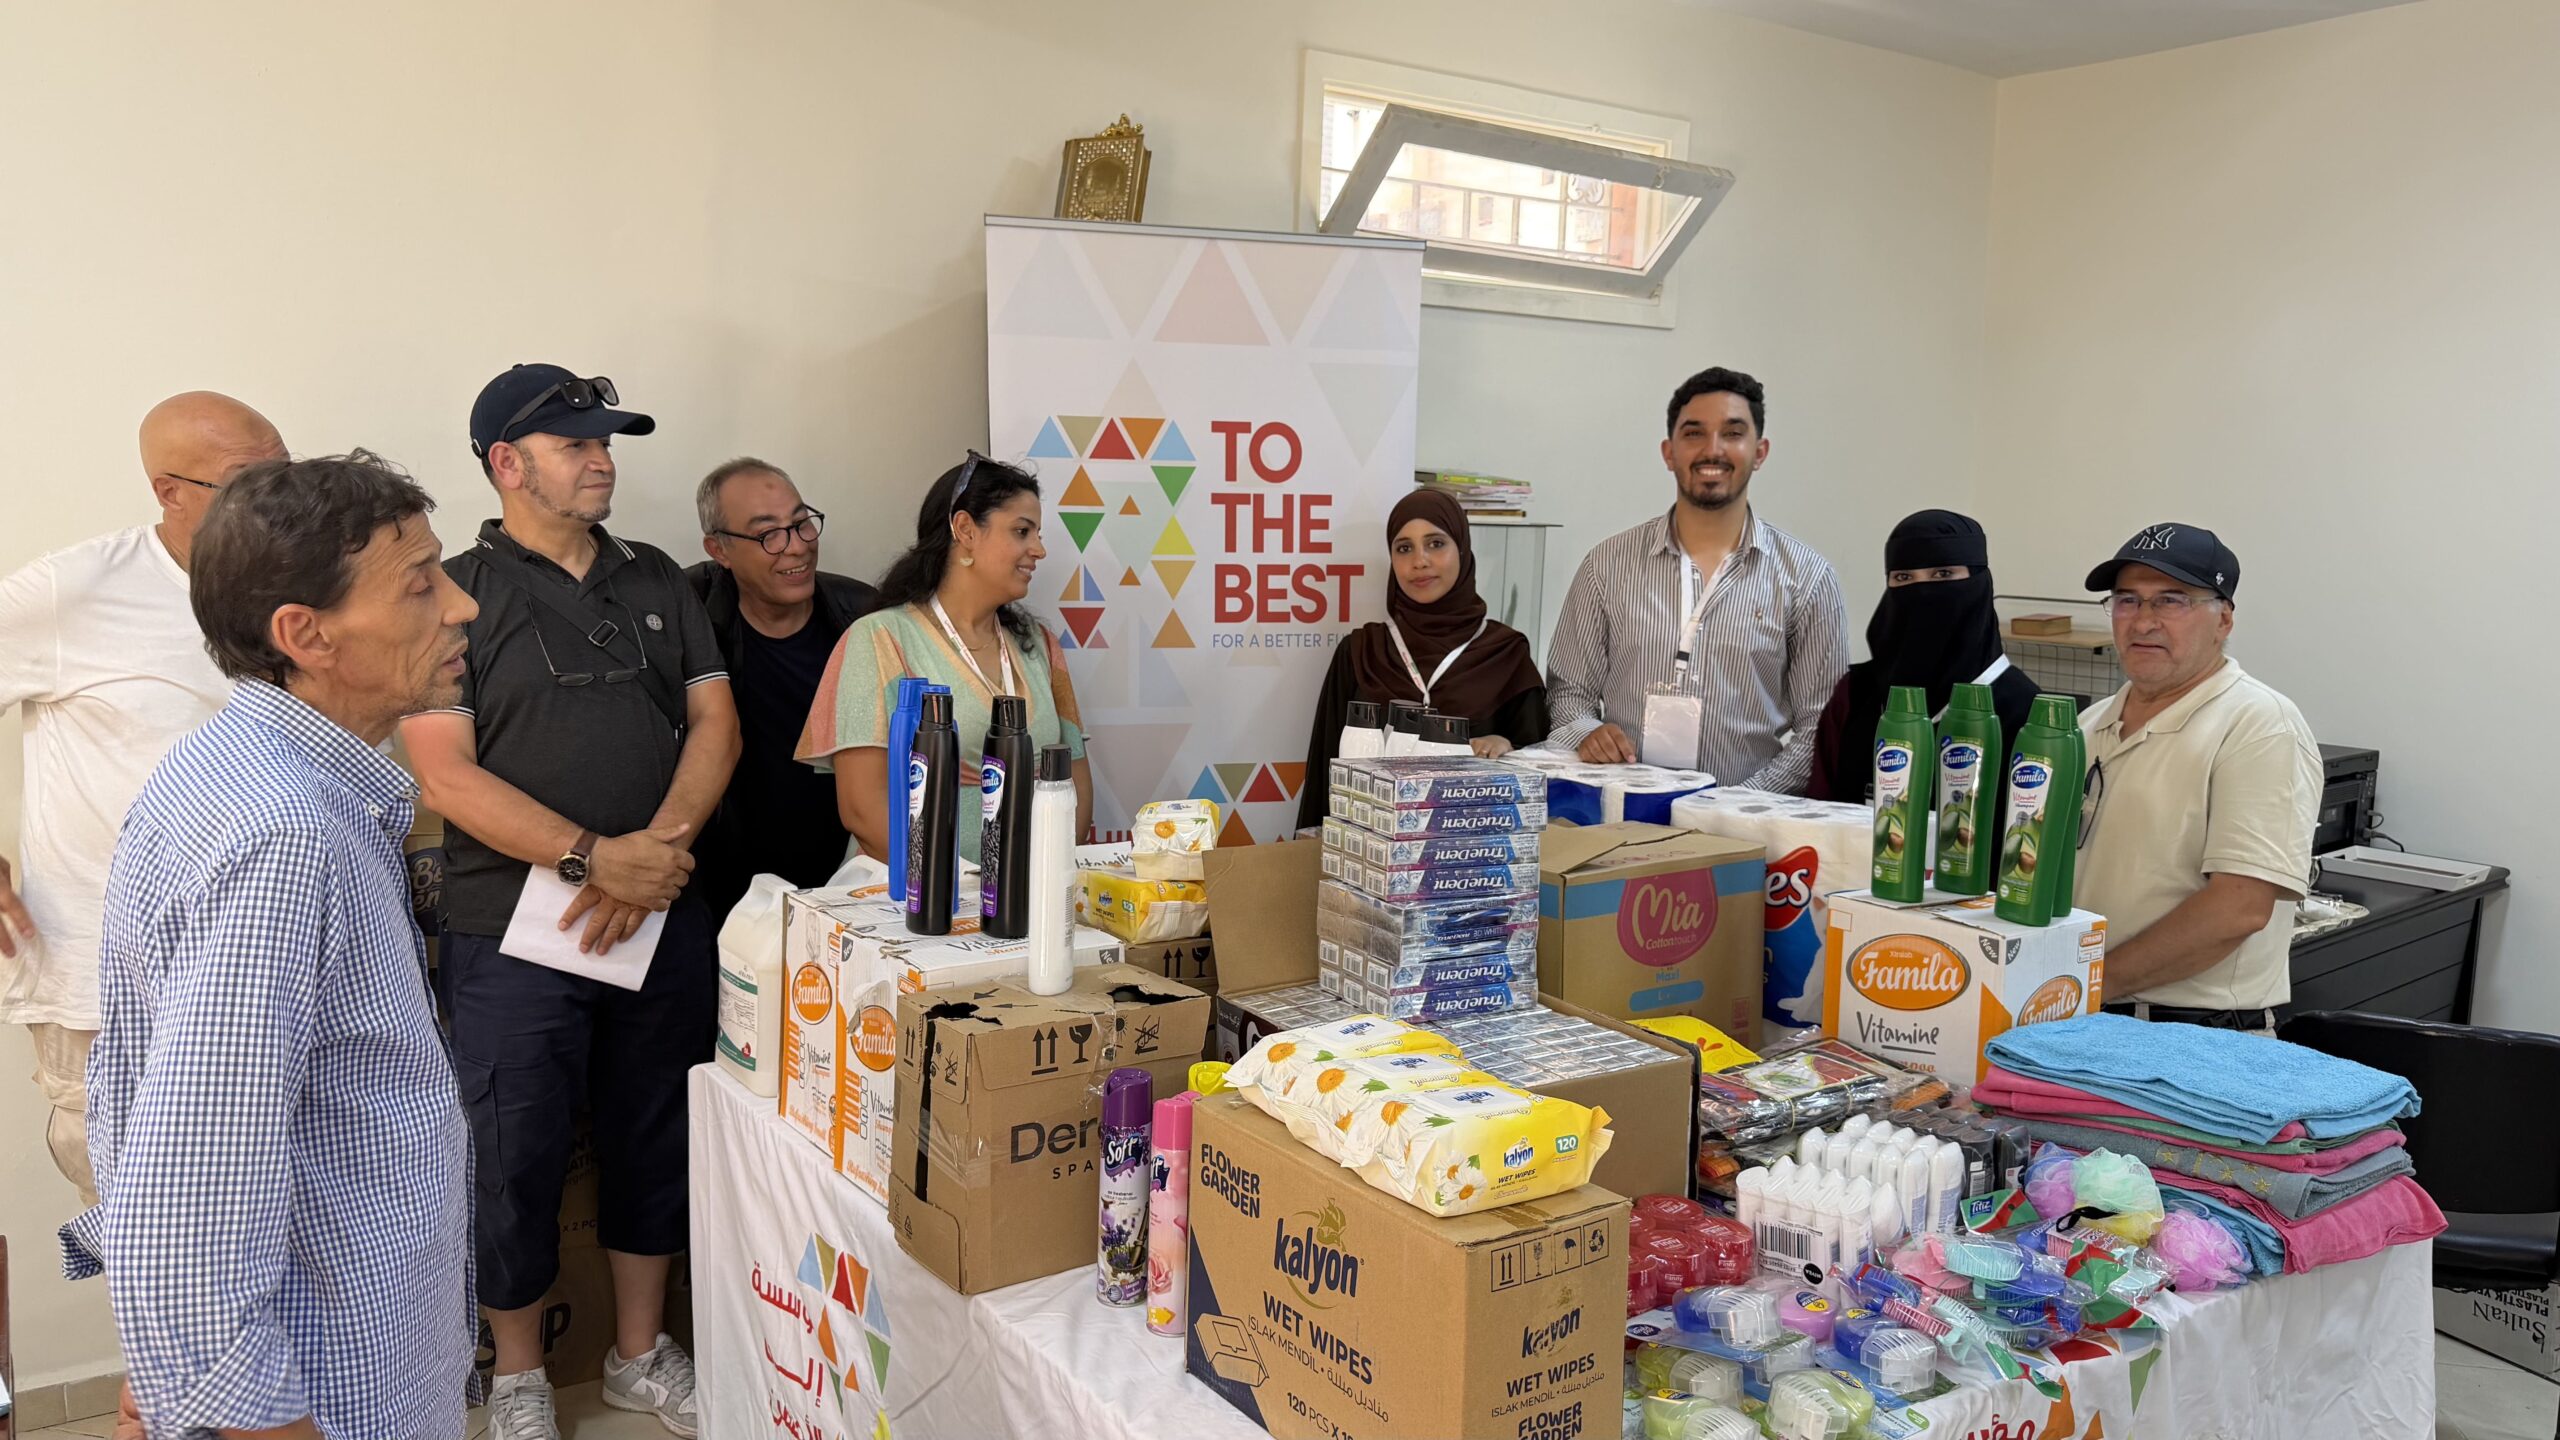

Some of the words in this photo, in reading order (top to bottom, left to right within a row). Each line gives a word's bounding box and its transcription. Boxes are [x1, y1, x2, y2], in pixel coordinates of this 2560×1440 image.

[1211, 420, 1303, 483] TO
[1211, 494, 1332, 554] THE
[1213, 563, 1365, 625] BEST
[1212, 633, 1245, 648] FOR
[1249, 633, 1260, 648] A
[1265, 633, 1322, 648] BETTER
[1878, 754, 1907, 769] Famila
[1943, 750, 1976, 765] Famila
[2013, 769, 2046, 784] Famila
[1441, 785, 1512, 799] TrueDent
[1441, 815, 1512, 829] TrueDent
[1434, 847, 1504, 861] TrueDent
[1433, 876, 1503, 891] TrueDent
[1632, 884, 1705, 948] Mia
[1980, 938, 1998, 959] New
[2007, 942, 2020, 960] New
[1435, 963, 1503, 981] TrueDent
[1858, 951, 1961, 992] Famila
[1435, 994, 1503, 1012] TrueDent
[1339, 1022, 1375, 1036] kalyon
[1856, 1011, 1940, 1045] Vitamine
[1390, 1057, 1428, 1068] kalyon
[1453, 1090, 1495, 1103] kalyon
[1010, 1117, 1104, 1164] Der
[1106, 1136, 1139, 1165] Soft
[1557, 1136, 1577, 1151] 120
[1503, 1146, 1534, 1167] kalyon
[1052, 1160, 1094, 1180] SPA
[1201, 1143, 1260, 1196] FLOWER
[1498, 1174, 1513, 1184] WET
[1515, 1168, 1537, 1179] WIPES
[1201, 1165, 1260, 1219] GARDEN
[1971, 1198, 1993, 1214] Titiz
[1273, 1217, 1361, 1299] kalyon
[1805, 1268, 1822, 1279] NIVEA
[1263, 1291, 1303, 1338] WET
[1309, 1320, 1374, 1385] WIPES
[1278, 1335, 1319, 1374] MENDİL
[1327, 1367, 1354, 1398] مبللة
[1506, 1371, 1543, 1398] WET
[1548, 1353, 1595, 1385] WIPES
[1354, 1390, 1389, 1422] مناديل
[1520, 1389, 1556, 1411] MENDİL
[1287, 1391, 1307, 1417] 120
[1309, 1407, 1329, 1434] PCS
[1518, 1401, 1582, 1438] FLOWER
